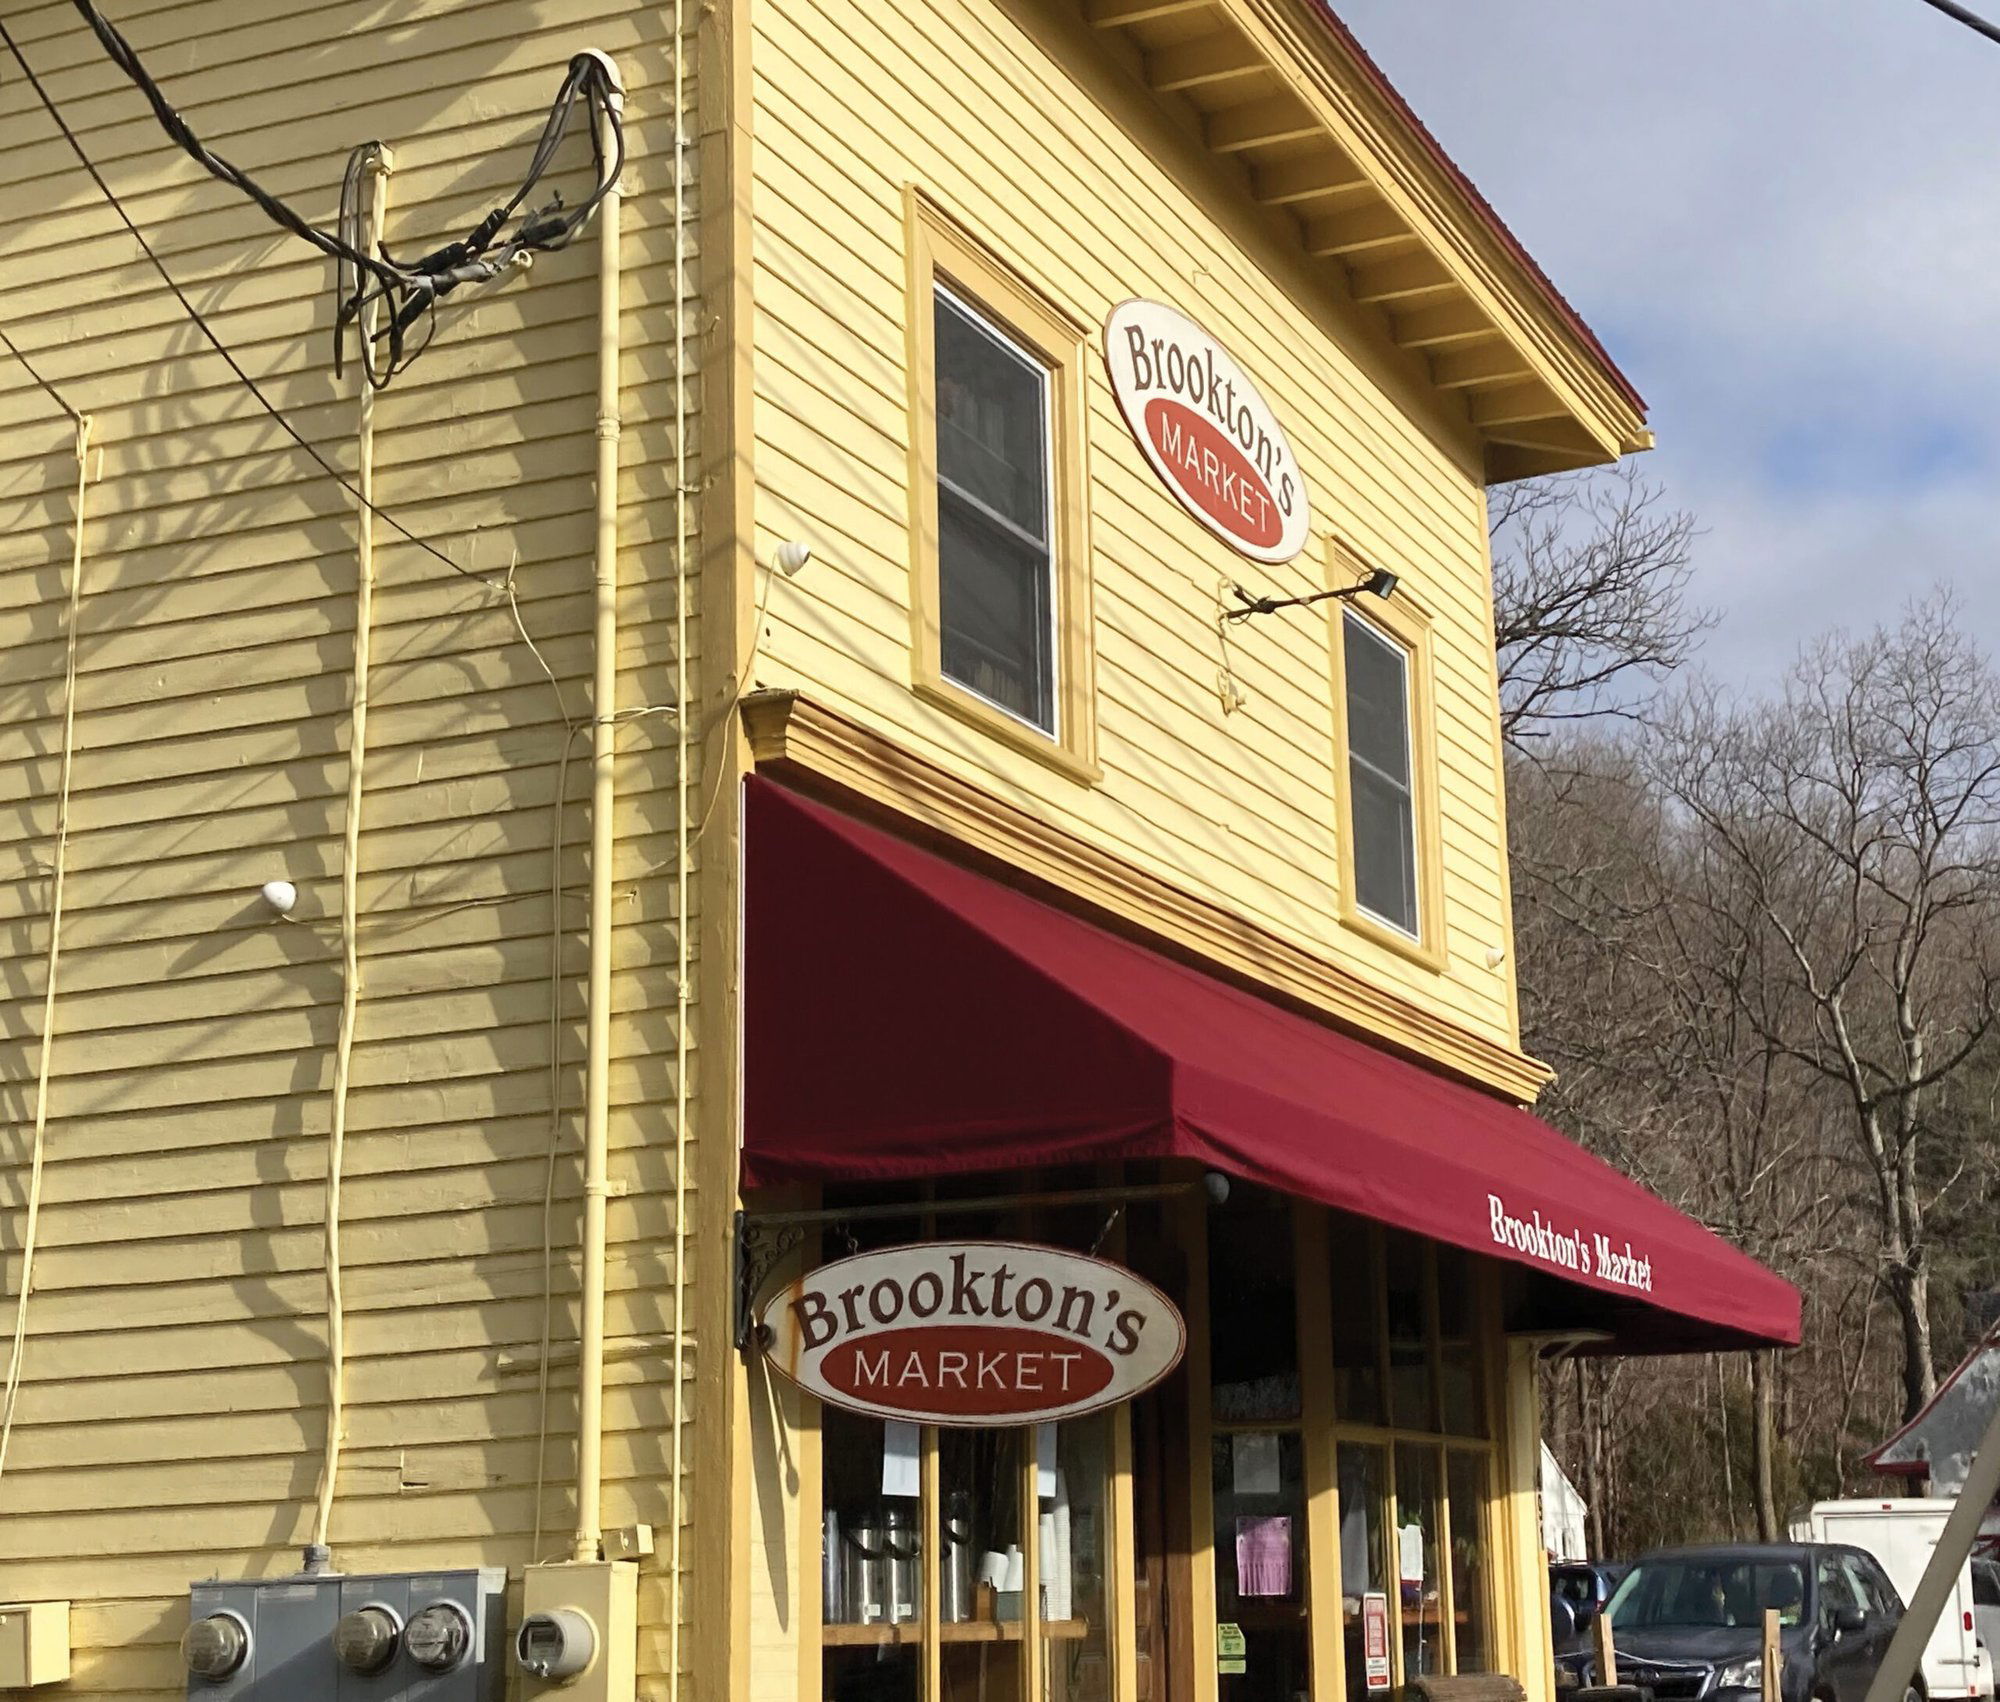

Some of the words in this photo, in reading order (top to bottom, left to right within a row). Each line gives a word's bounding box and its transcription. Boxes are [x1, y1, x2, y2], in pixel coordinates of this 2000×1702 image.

[1124, 324, 1295, 518] Brookton's
[1161, 411, 1270, 533] MARKET
[1487, 1193, 1591, 1275] Brookton's
[1593, 1232, 1652, 1292] Market
[790, 1252, 1148, 1356] Brookton's
[853, 1350, 1082, 1392] MARKET
